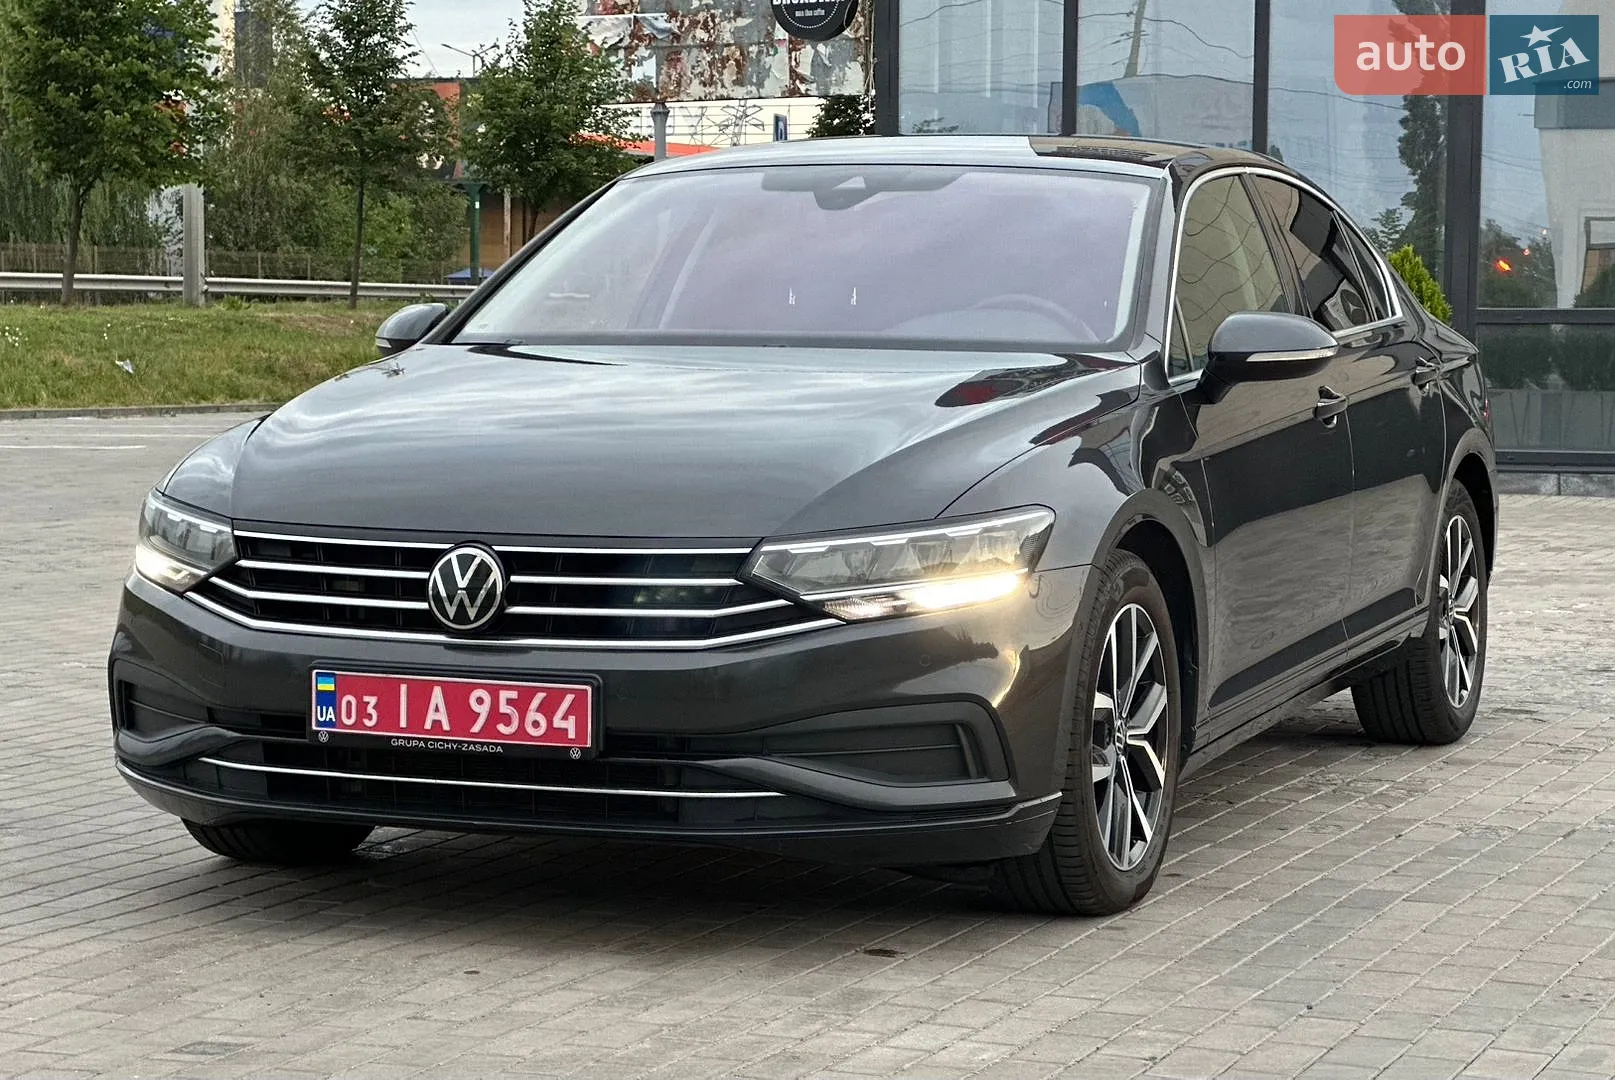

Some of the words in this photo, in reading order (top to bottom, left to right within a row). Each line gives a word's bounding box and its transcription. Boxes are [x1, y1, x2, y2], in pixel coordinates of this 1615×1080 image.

[317, 705, 336, 722] UA
[340, 695, 378, 728] 03
[468, 688, 576, 739] 9564
[390, 738, 426, 749] GRUPA
[427, 740, 504, 753] CICHY-ZASADA
